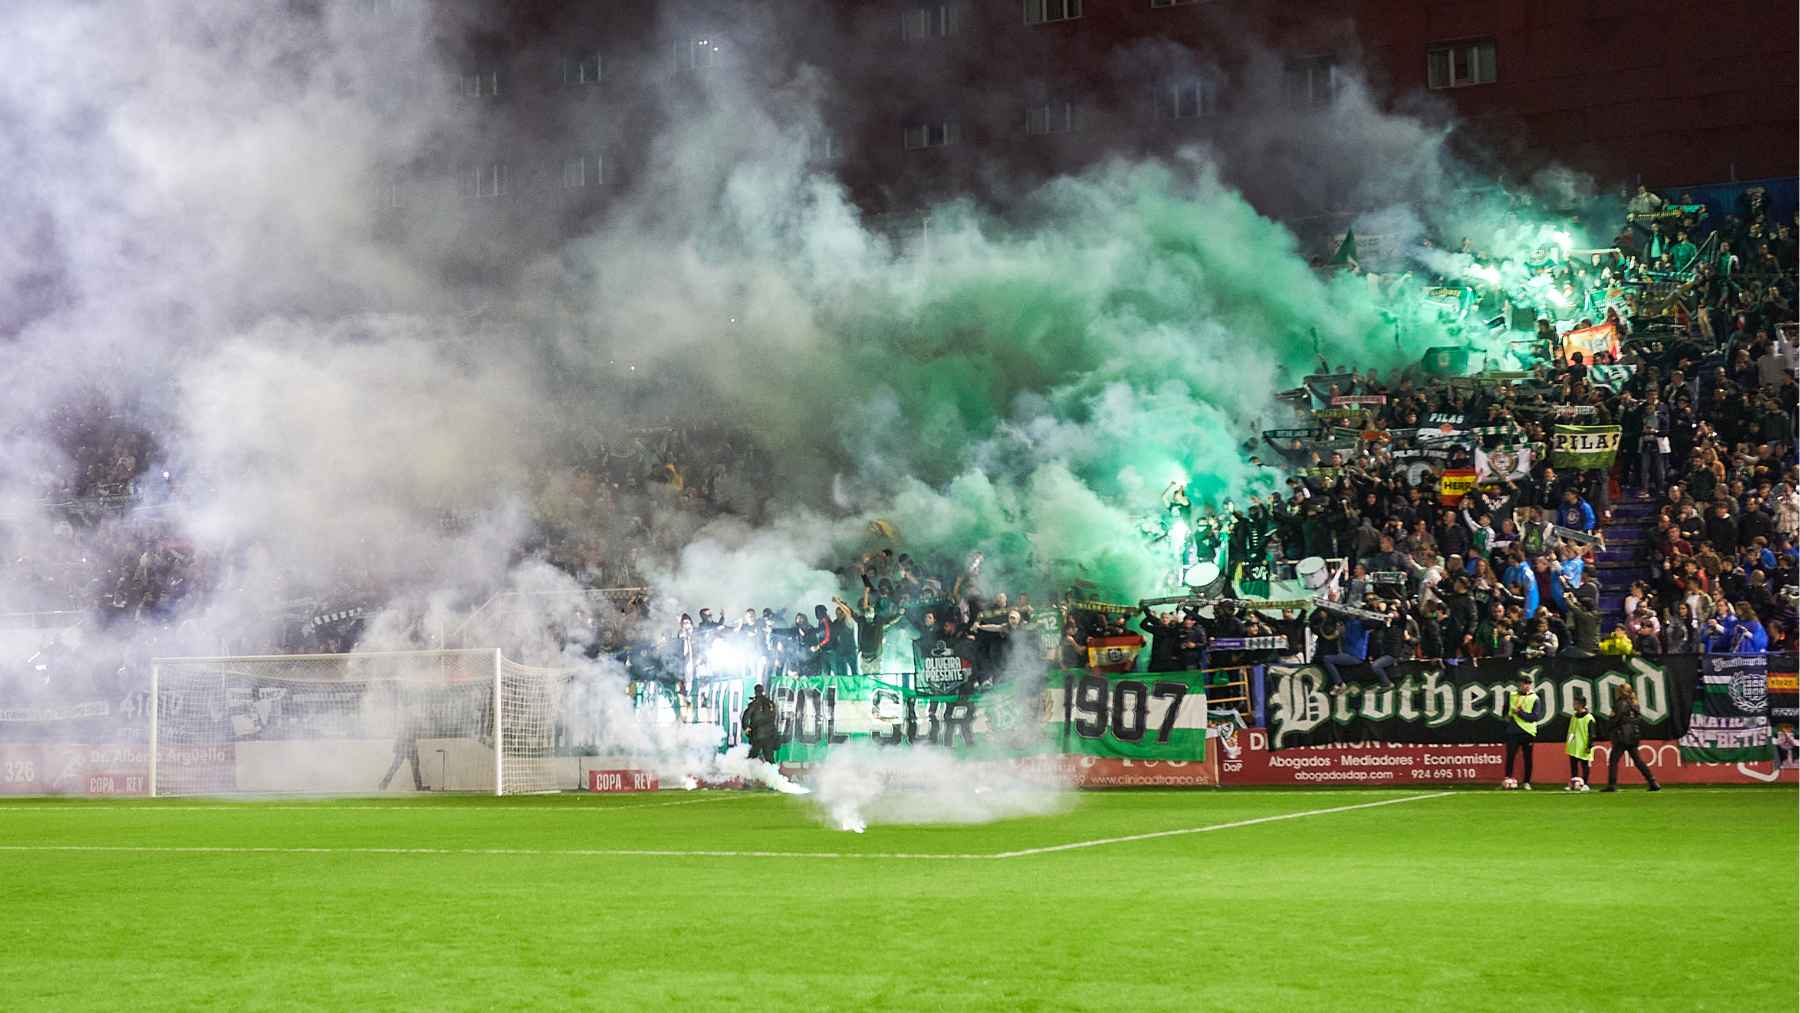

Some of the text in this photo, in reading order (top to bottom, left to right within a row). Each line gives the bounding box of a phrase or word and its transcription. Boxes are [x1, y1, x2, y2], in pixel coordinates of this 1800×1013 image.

[925, 657, 961, 671] OLIVEIRA
[925, 669, 964, 682] PRESENTE
[1063, 673, 1188, 744] 1907
[113, 749, 163, 764] Albero
[1269, 753, 1503, 769] Abogados Mediadores Economistas
[5, 761, 35, 783] 326
[1295, 770, 1394, 782] abogadosdap.com
[1411, 768, 1476, 779] 924 695 110
[90, 776, 144, 792] COPA REY
[596, 773, 652, 791] COPA REY
